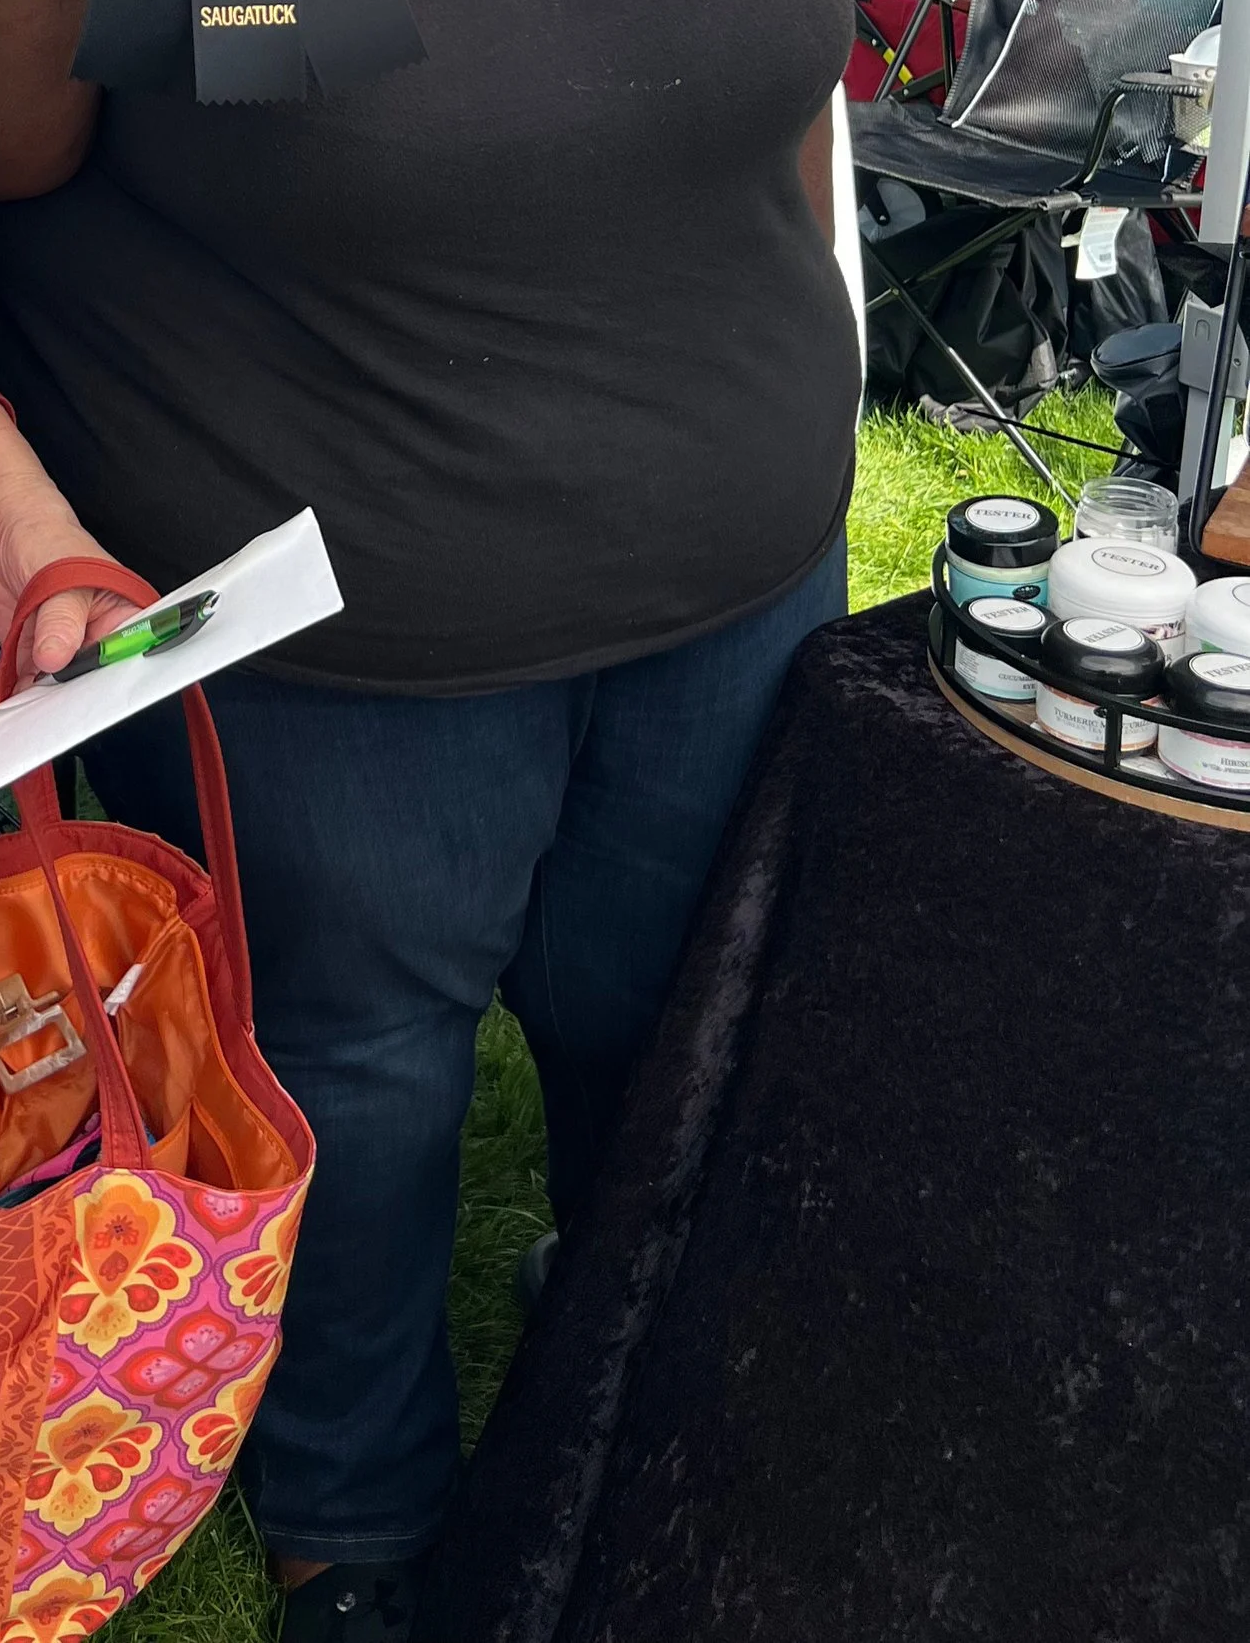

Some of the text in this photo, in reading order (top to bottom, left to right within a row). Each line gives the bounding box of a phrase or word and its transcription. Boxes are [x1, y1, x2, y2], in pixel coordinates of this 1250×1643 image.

[200, 4, 298, 28] SAUGATUCK
[973, 508, 1033, 521] TESTER
[1099, 551, 1161, 571] TESTER
[980, 605, 1031, 620] TESTER
[1082, 625, 1129, 645] TESTER
[1053, 706, 1100, 728] TURMERIC
